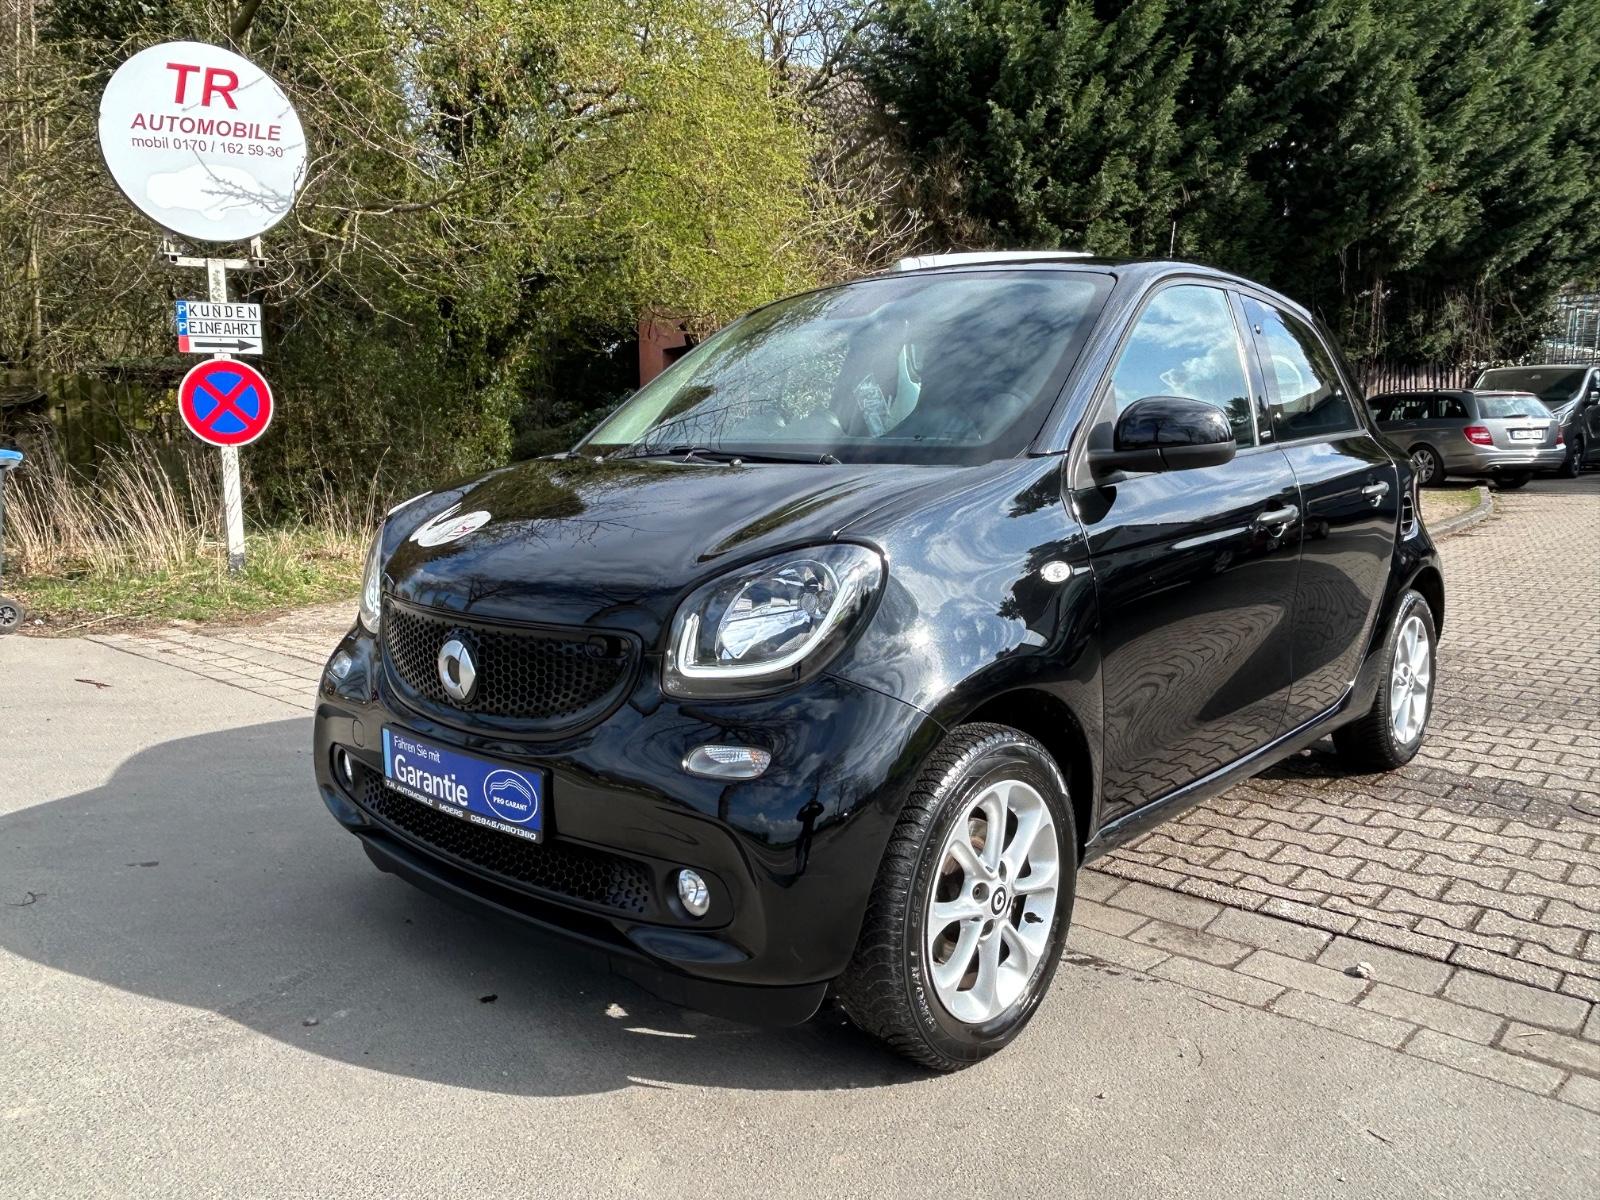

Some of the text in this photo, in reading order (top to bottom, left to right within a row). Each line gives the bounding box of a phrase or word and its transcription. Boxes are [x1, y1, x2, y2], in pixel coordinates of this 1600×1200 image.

[166, 62, 239, 110] TR
[130, 113, 281, 141] AUTOMOBILE
[131, 137, 284, 158] mobil 0170 / 162 59 30
[189, 304, 257, 318] KUNDEN
[189, 322, 257, 335] EINFAHRT
[394, 735, 441, 764] Fahren Sie mit
[394, 754, 469, 807] Garantie
[397, 786, 433, 806] AUTOMOBILE
[439, 803, 464, 818] MOERS
